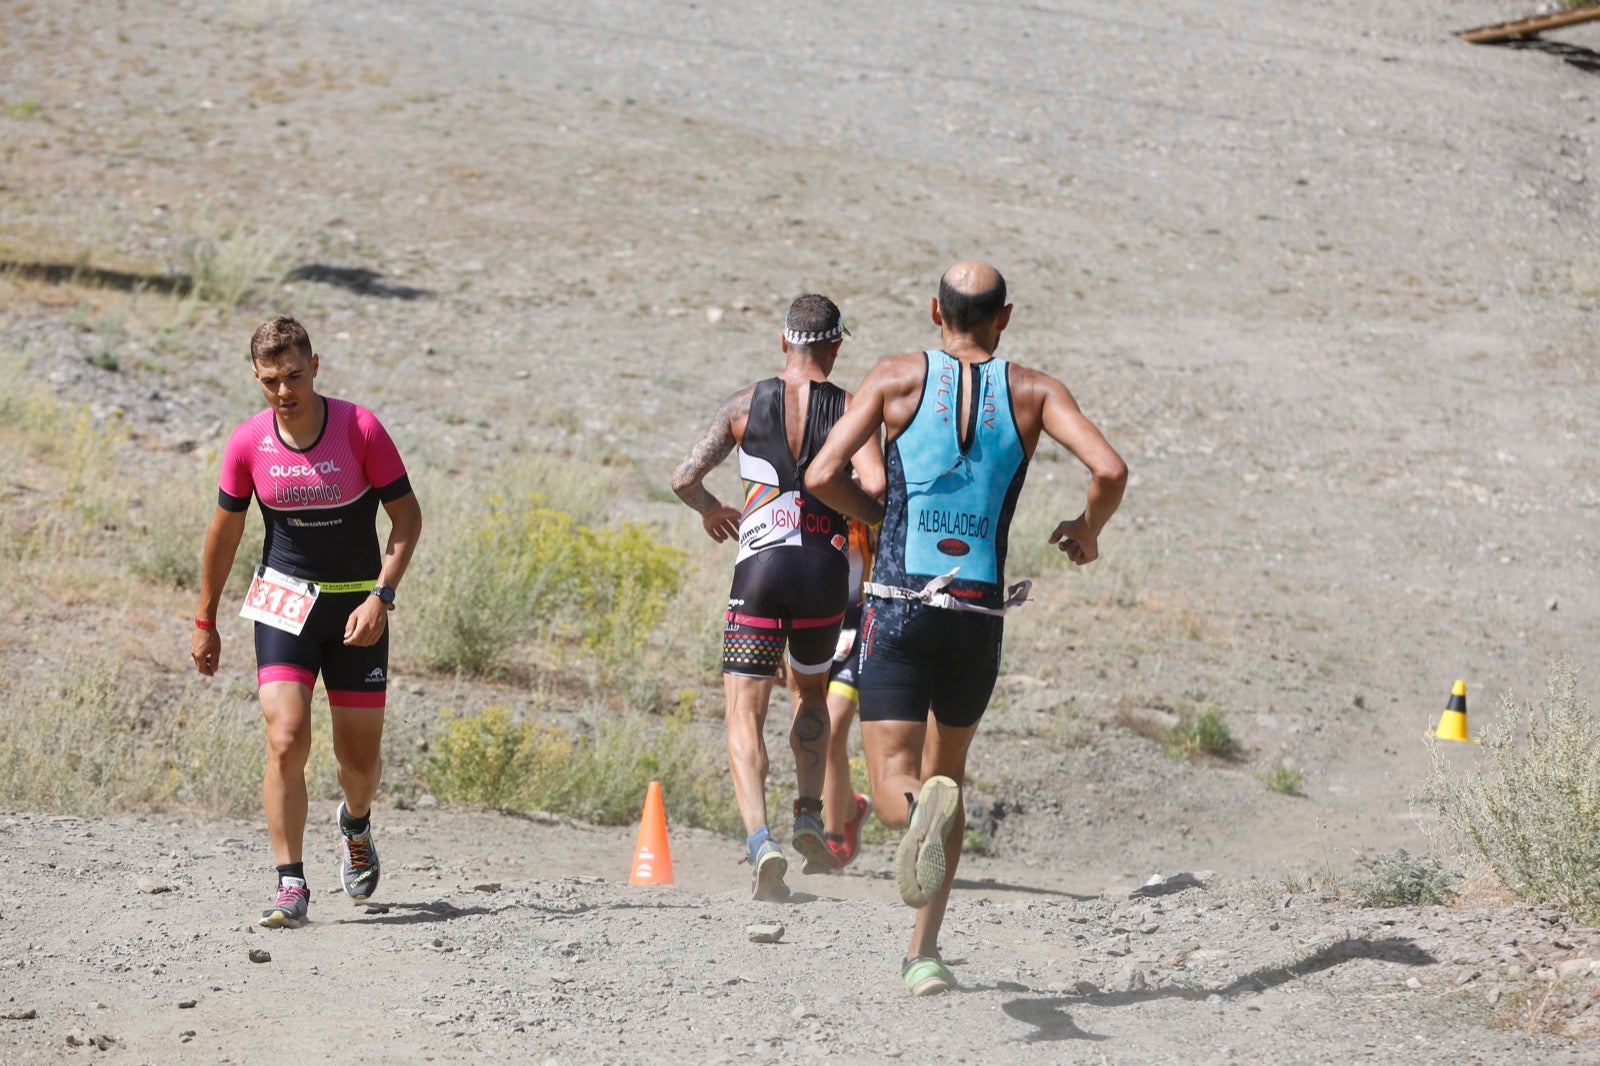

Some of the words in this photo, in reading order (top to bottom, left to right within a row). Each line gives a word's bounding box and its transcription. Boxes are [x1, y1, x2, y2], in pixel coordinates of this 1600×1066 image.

[269, 459, 342, 478] austral
[771, 508, 832, 535] IGNACIO
[917, 509, 991, 539] ALBALADEJO
[251, 582, 305, 619] 318
